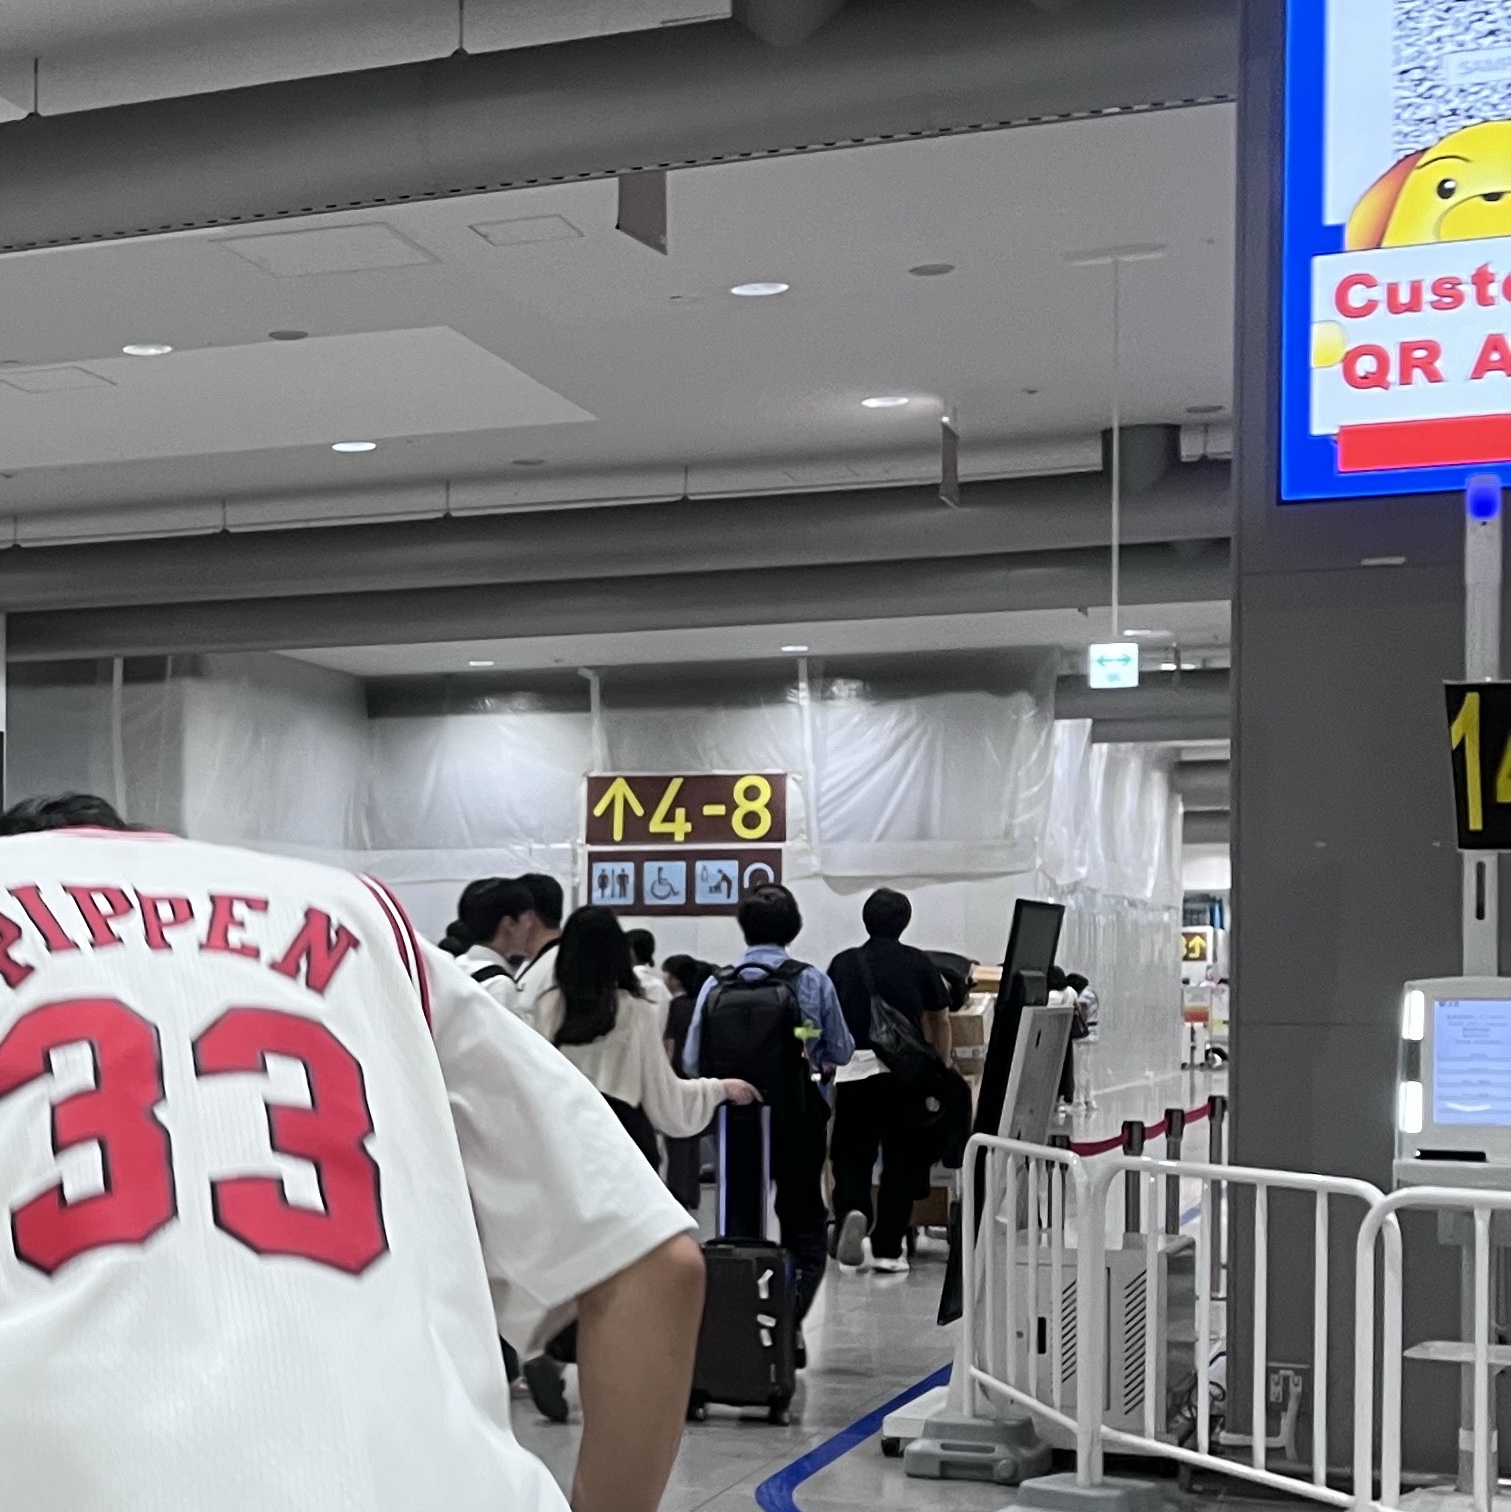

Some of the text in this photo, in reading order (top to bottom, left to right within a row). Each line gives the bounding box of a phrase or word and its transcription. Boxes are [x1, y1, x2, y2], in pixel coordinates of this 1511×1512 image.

[1334, 262, 1511, 319] Cust
[1342, 339, 1445, 391] QR
[648, 774, 773, 842] 4-8
